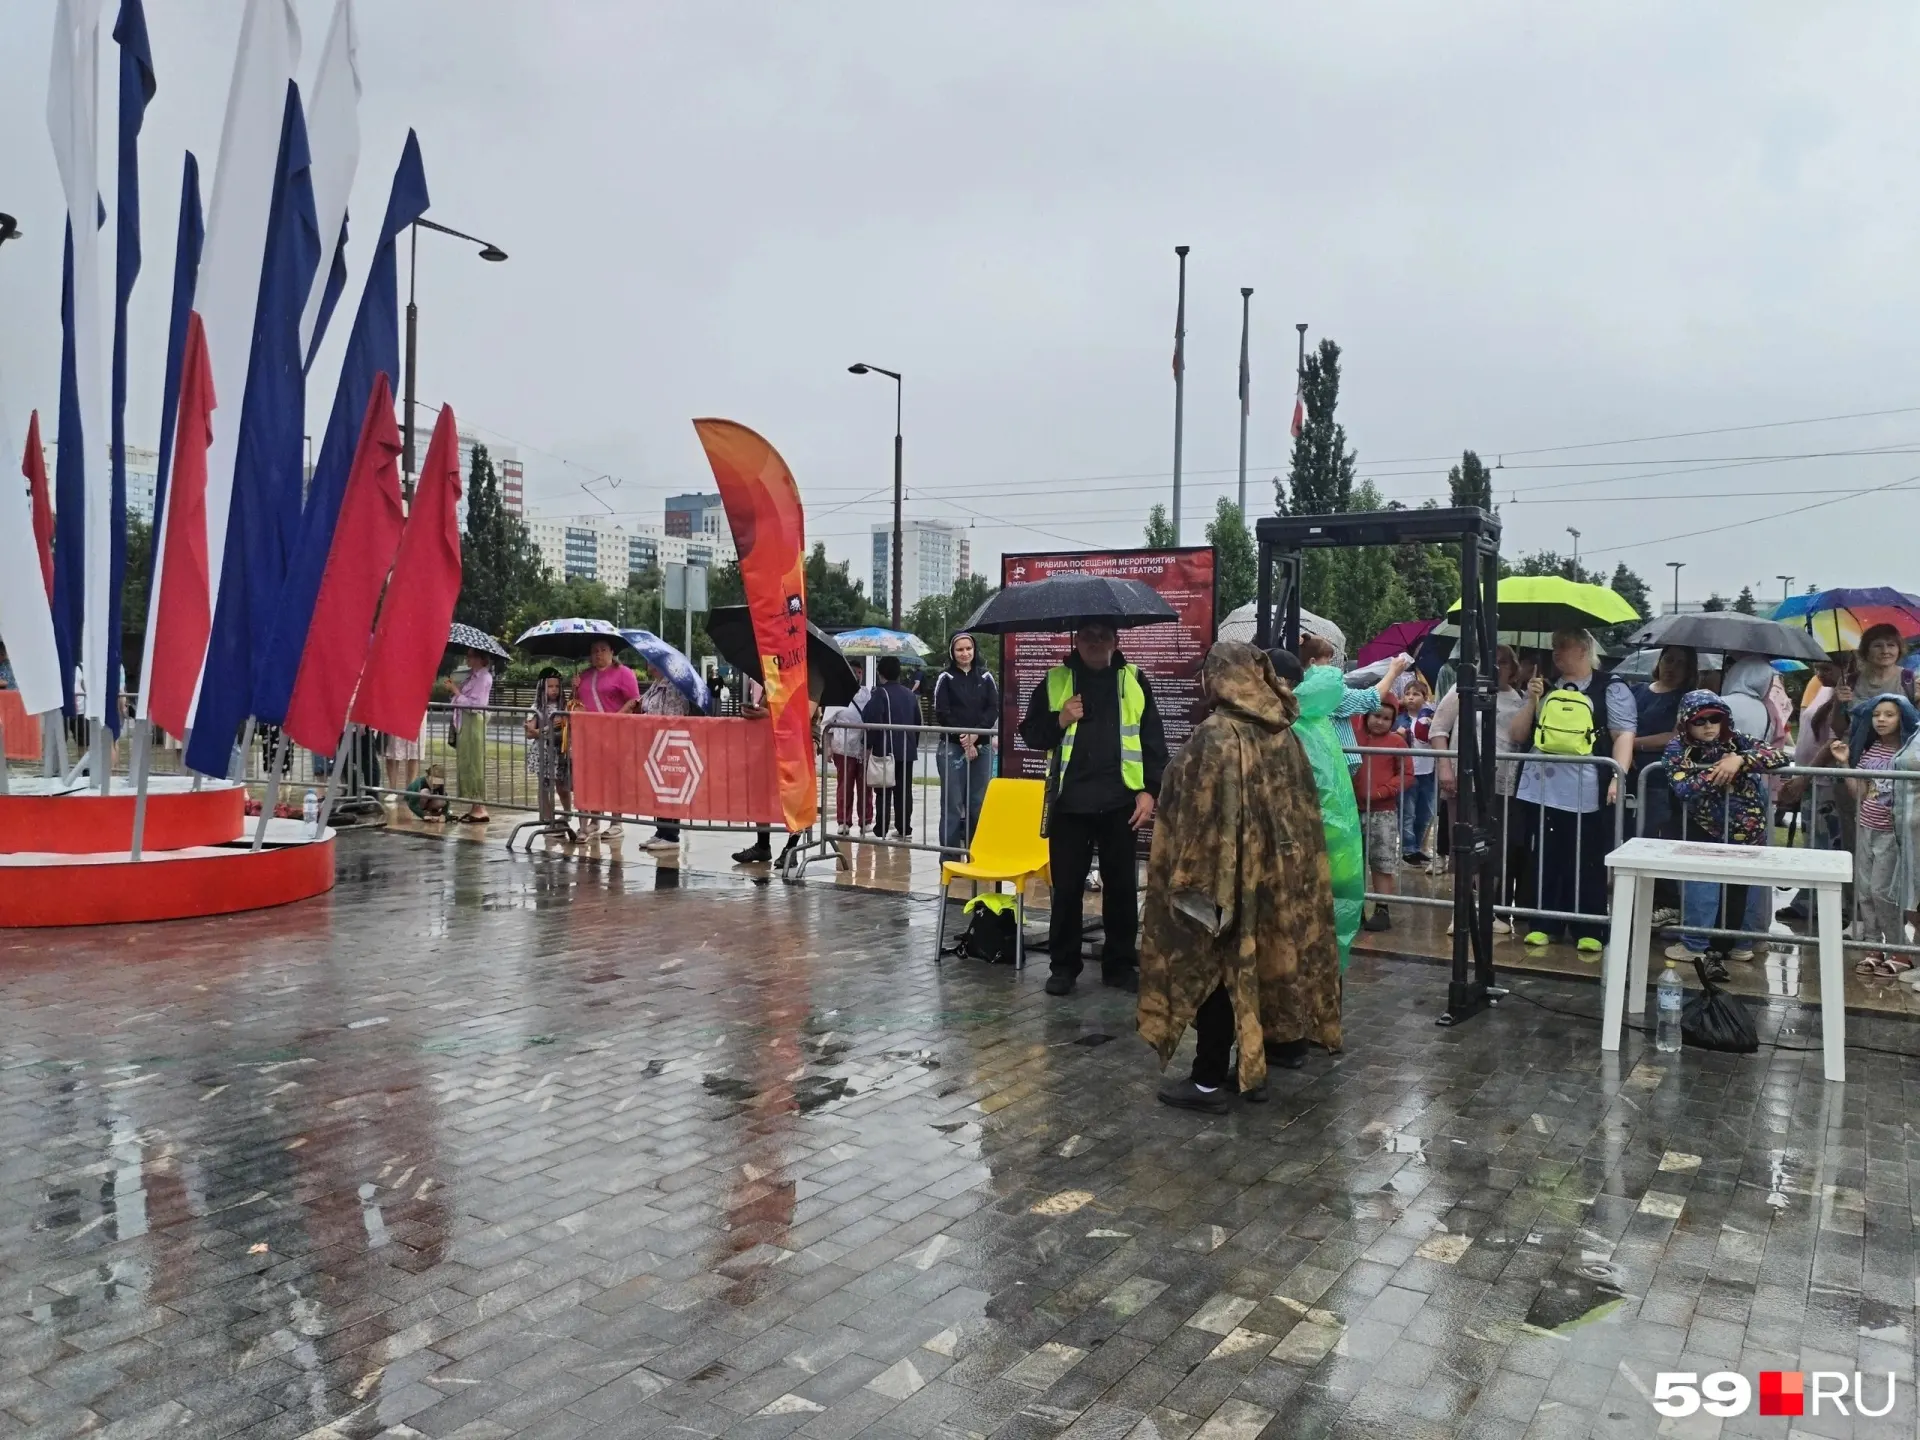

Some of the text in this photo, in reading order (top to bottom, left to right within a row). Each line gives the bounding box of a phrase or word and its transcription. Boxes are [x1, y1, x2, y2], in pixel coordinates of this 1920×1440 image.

[1070, 558, 1117, 568] ПОСЕЩЕНИЯ
[1118, 556, 1176, 566] МЕРОПРИЯТИЯ
[1046, 565, 1164, 577] ФЕСТВАЛЬ УЛИЧНЫХ ТЕАТРОВ
